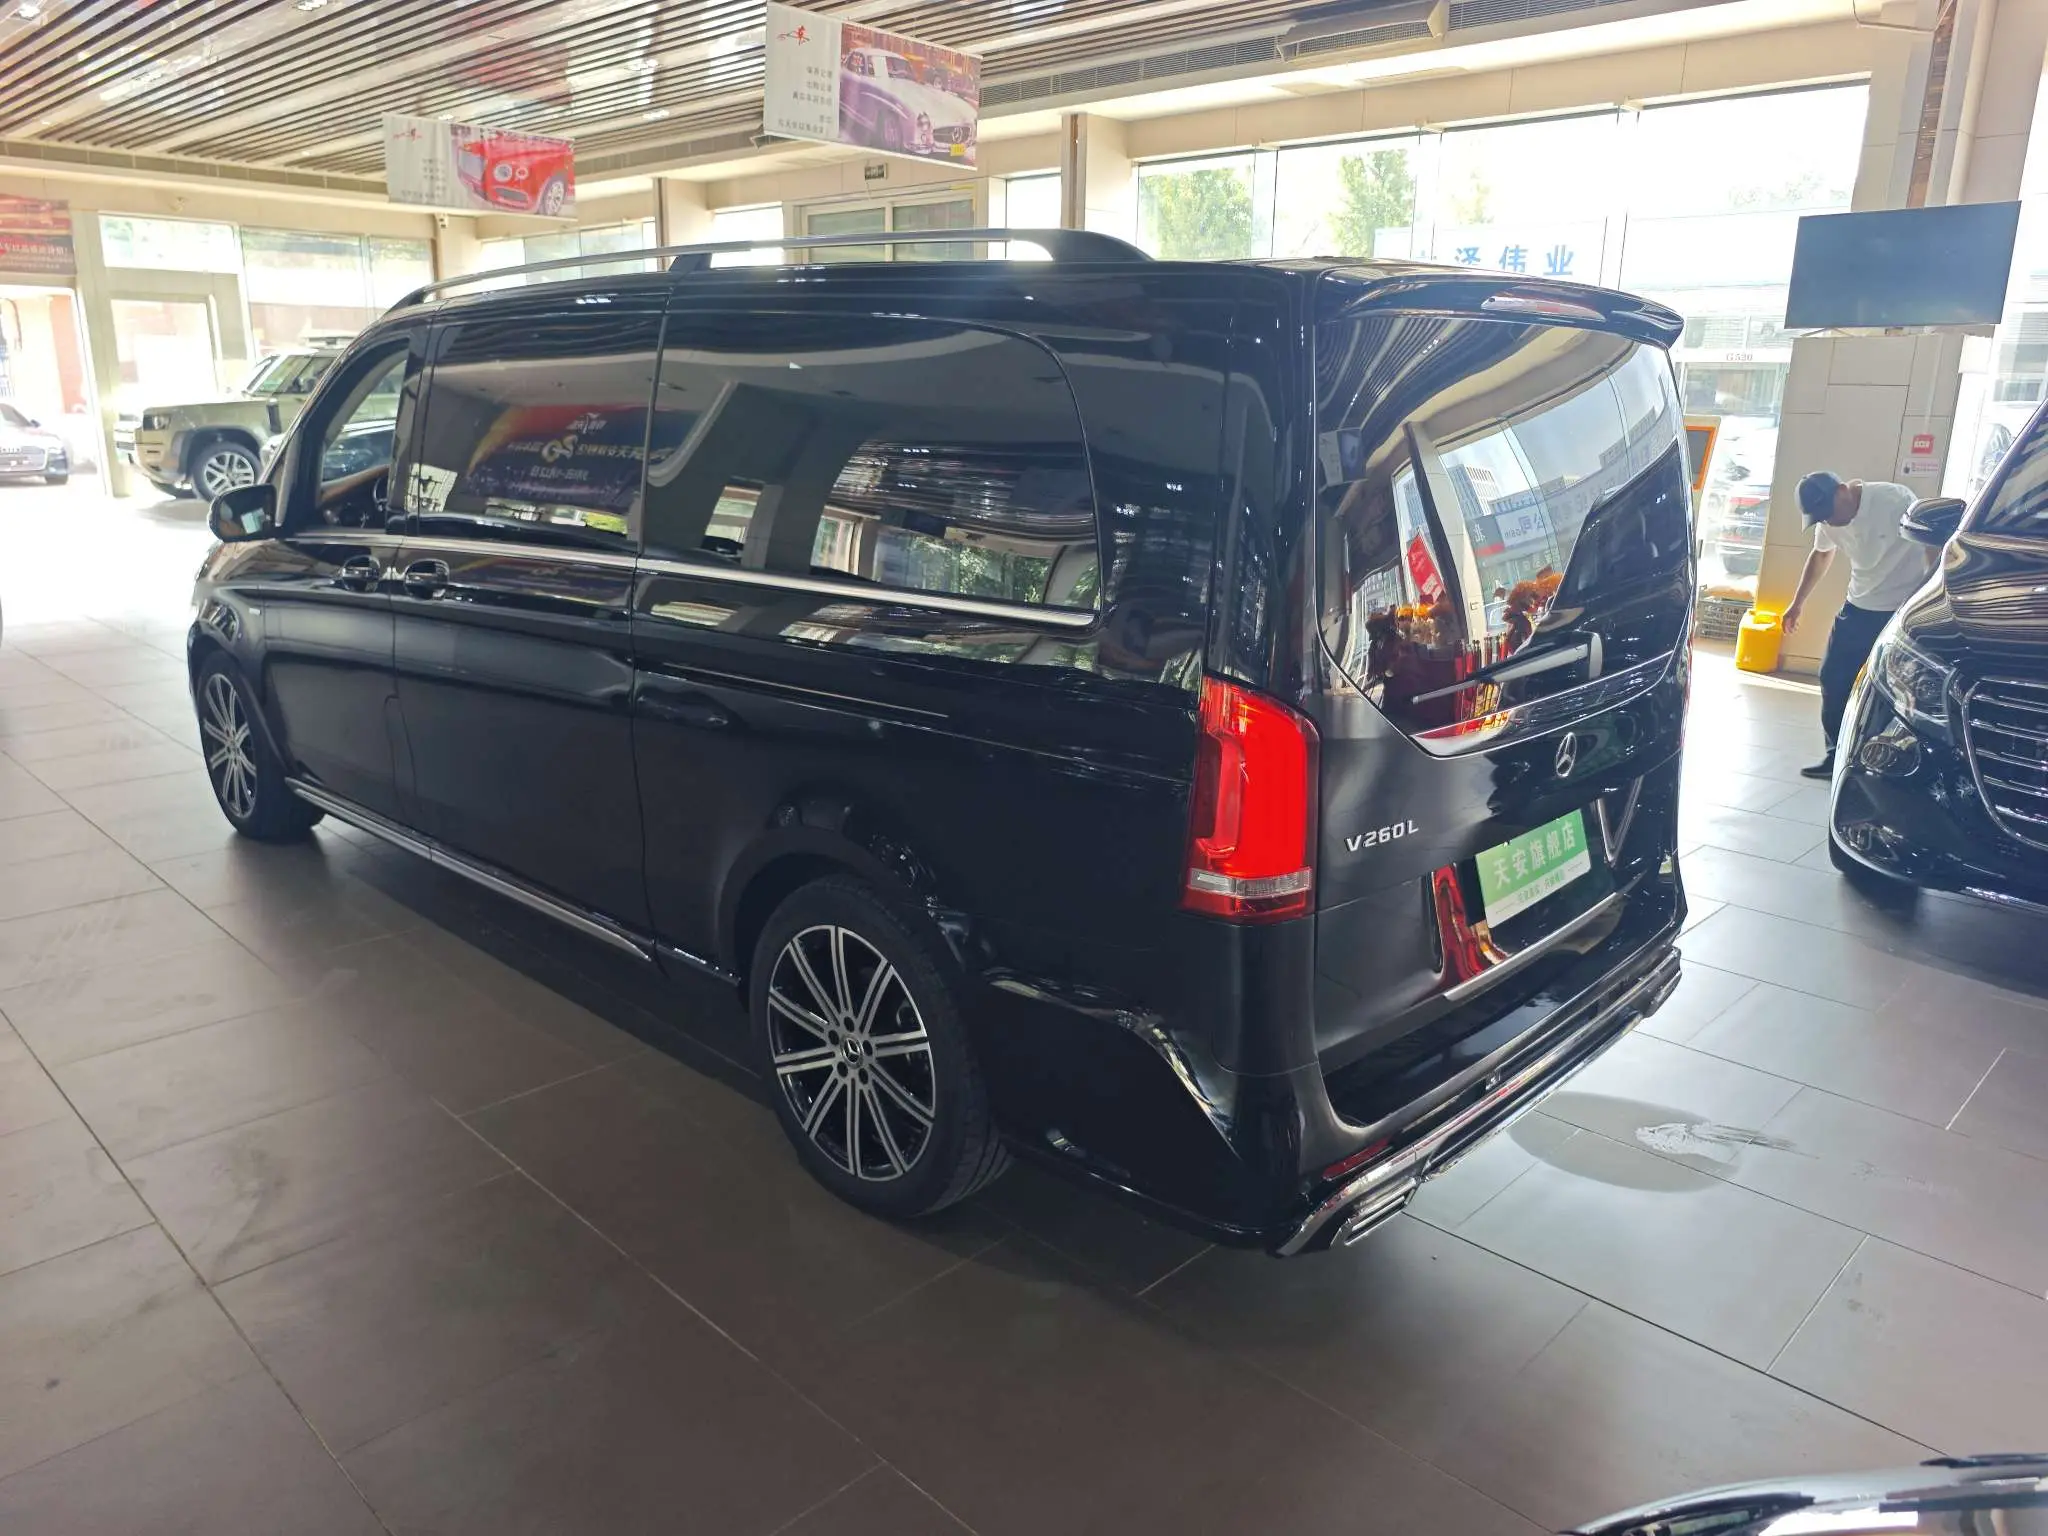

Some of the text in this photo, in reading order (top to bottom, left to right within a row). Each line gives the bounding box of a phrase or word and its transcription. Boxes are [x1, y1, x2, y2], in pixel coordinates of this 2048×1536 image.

[1346, 819, 1419, 852] V260L
[1493, 821, 1576, 890] 天安旗舰店
